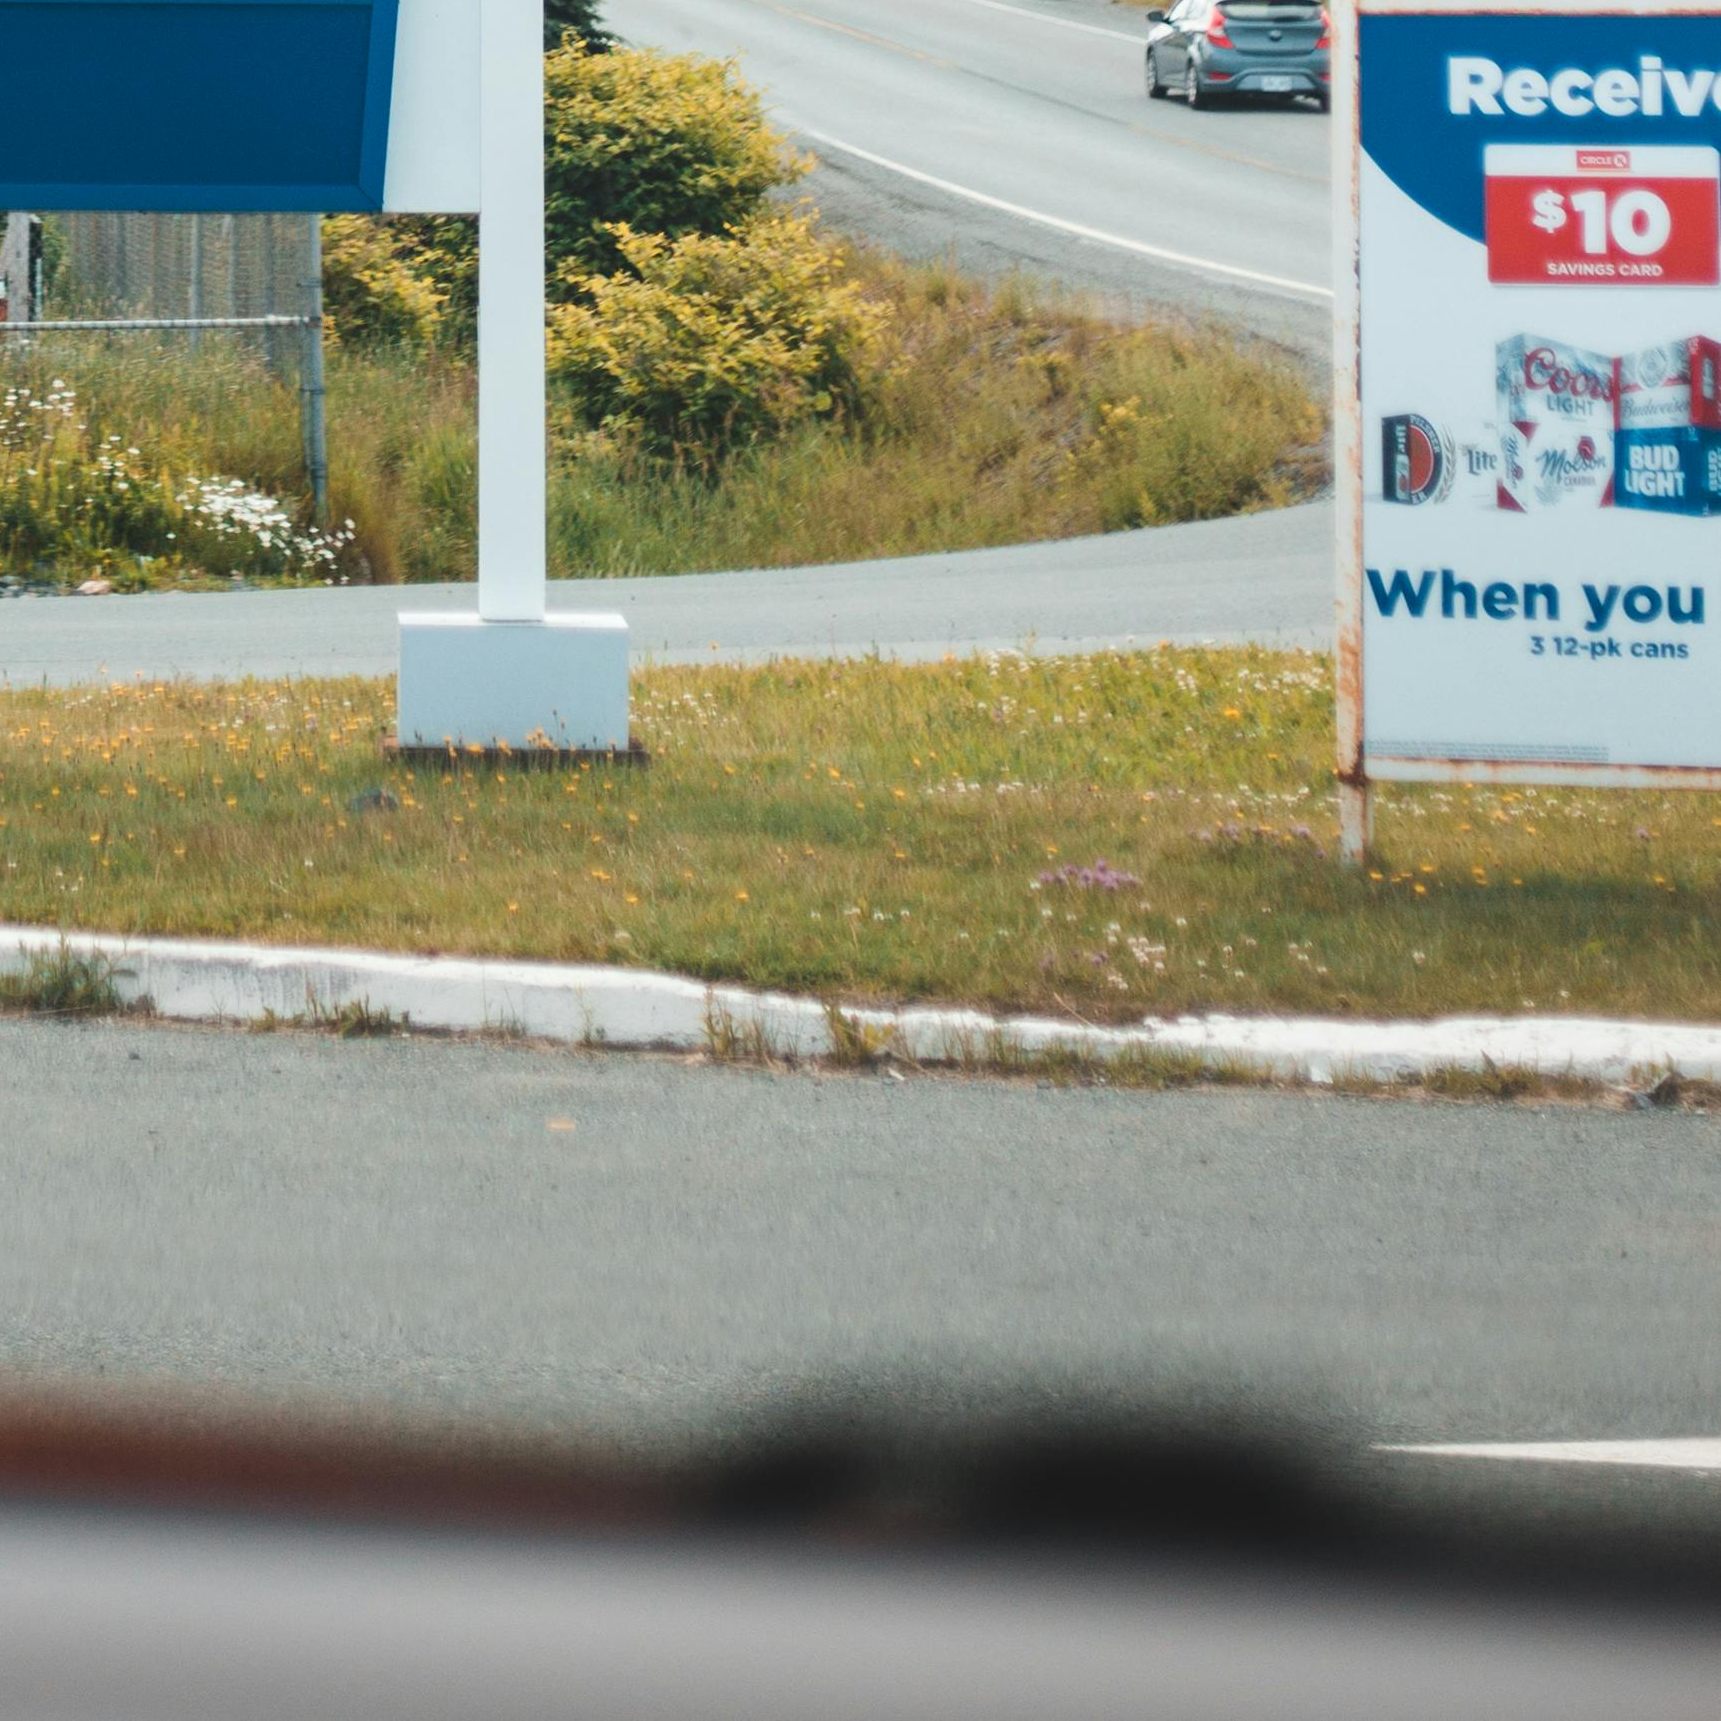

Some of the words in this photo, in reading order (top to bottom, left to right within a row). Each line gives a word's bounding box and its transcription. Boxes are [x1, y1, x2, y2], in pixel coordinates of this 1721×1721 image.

[1580, 156, 1612, 165] CIRCLE
[1532, 189, 1671, 256] $10
[1547, 263, 1614, 276] SAVINGS
[1619, 263, 1663, 276] CARD
[1525, 347, 1614, 403] Coors
[1546, 395, 1594, 416] LIGHT
[1467, 449, 1497, 475] Lite
[1535, 449, 1606, 483] Molson
[1629, 444, 1679, 471] BUD
[1625, 469, 1686, 497] LIGHT
[1365, 568, 1560, 621] When
[1581, 583, 1705, 633] you
[1530, 636, 1545, 656] 3
[1553, 637, 1623, 660] 12-pk
[1630, 641, 1689, 659] cans
